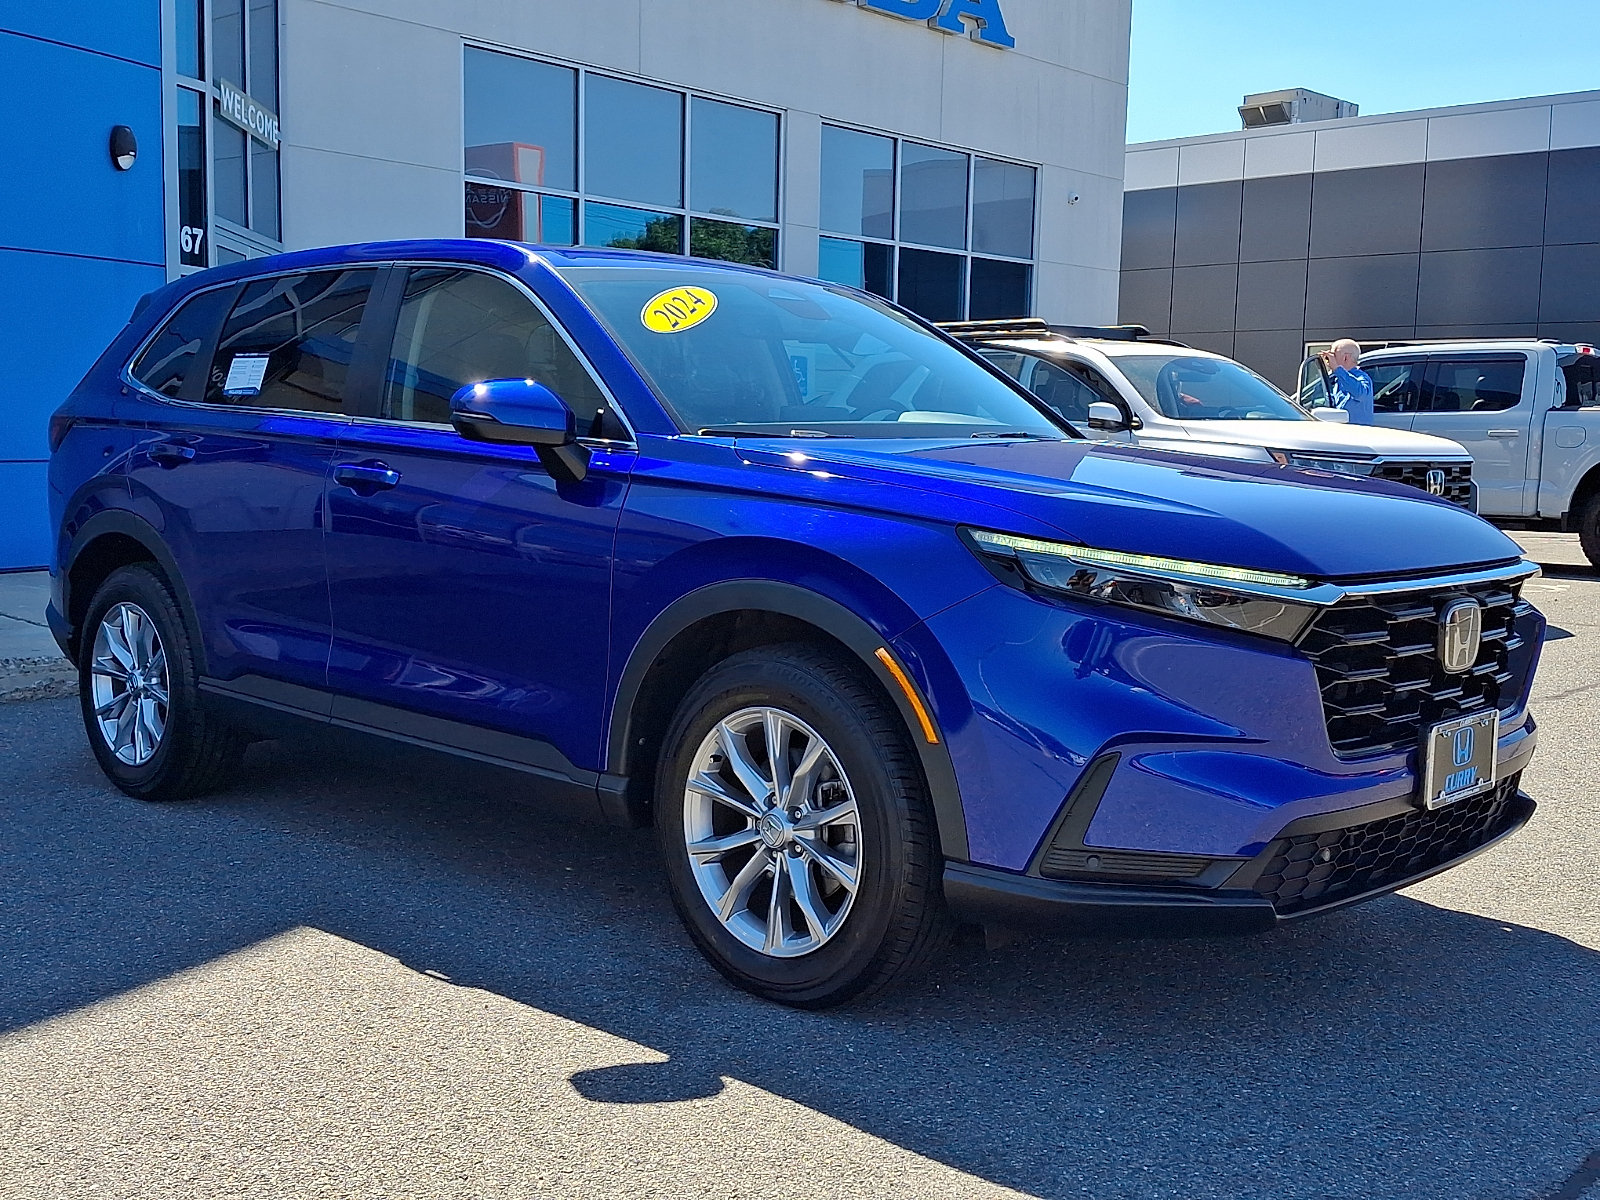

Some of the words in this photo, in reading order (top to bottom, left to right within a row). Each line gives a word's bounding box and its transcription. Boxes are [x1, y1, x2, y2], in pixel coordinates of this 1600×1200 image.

[220, 83, 279, 144] WELCOME
[180, 226, 204, 255] 67
[654, 289, 706, 328] 2024
[1445, 766, 1478, 793] CURRY
